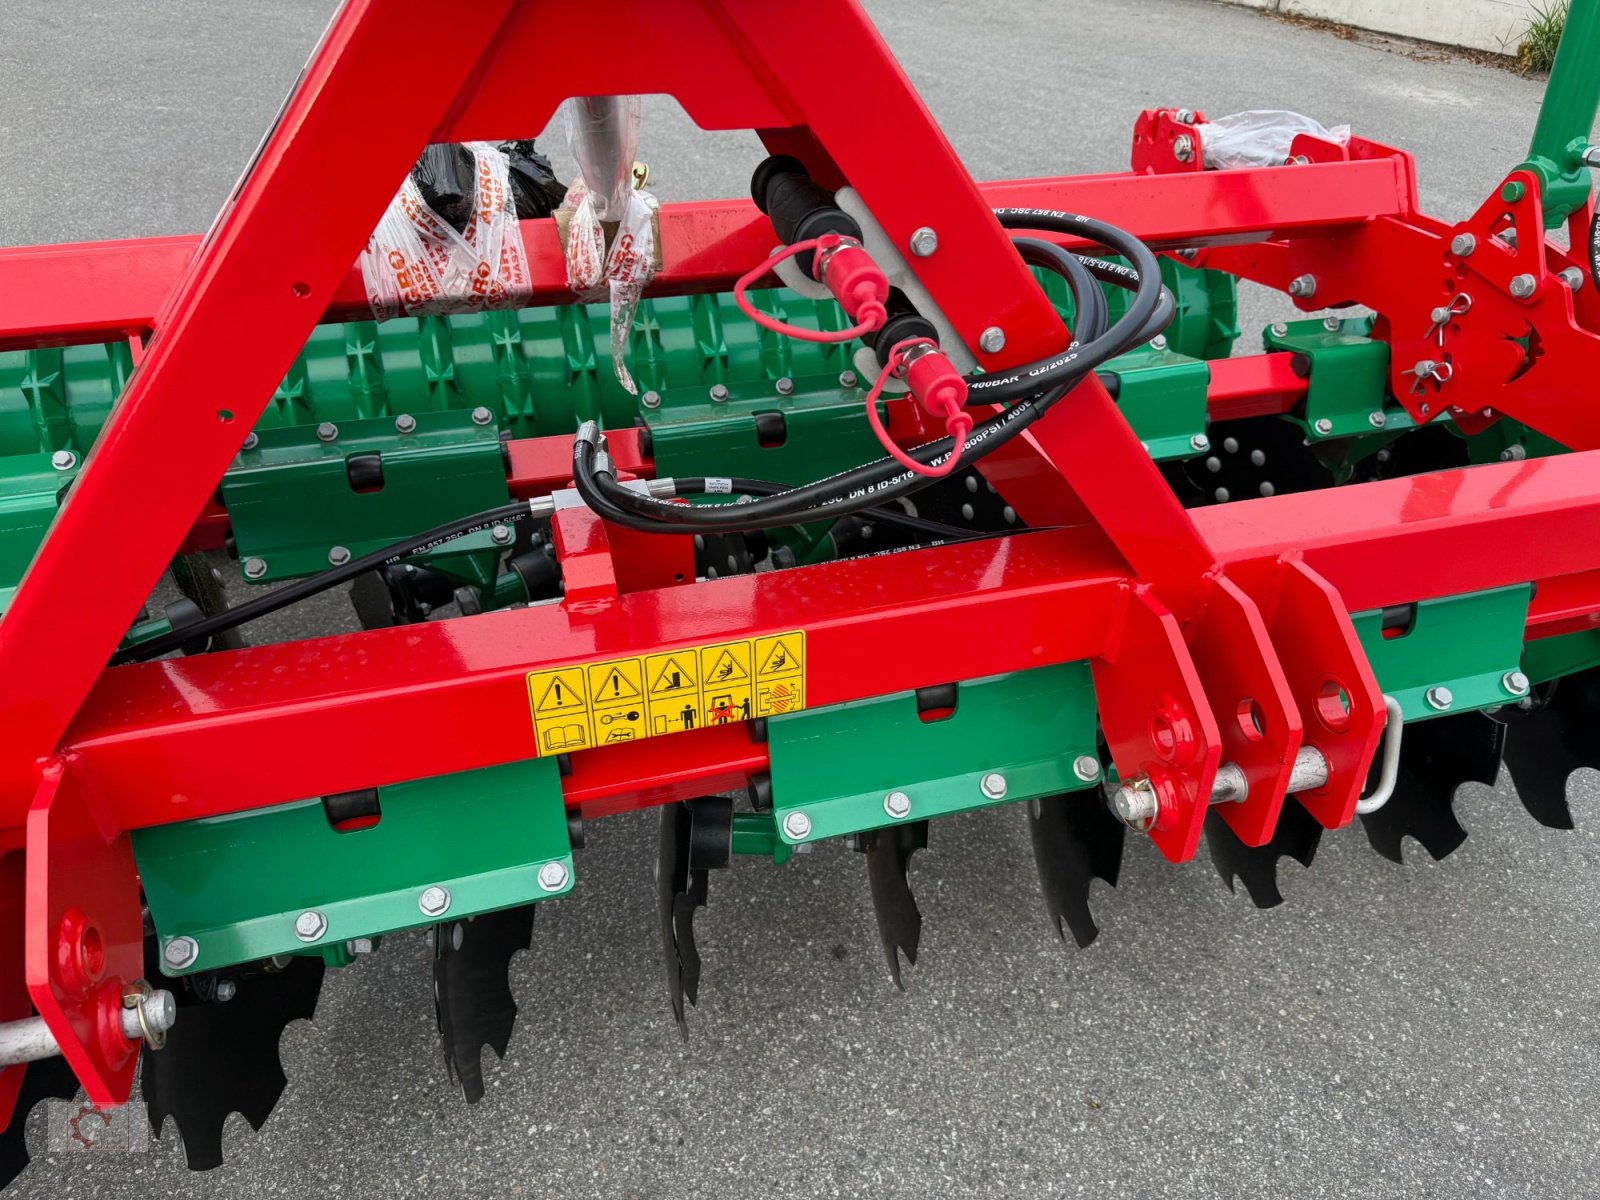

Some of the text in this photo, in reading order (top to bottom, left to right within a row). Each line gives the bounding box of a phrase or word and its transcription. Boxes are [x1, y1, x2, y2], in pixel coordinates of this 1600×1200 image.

[493, 179, 505, 213] MASZ
[1050, 210, 1066, 218] EN
[509, 245, 525, 285] MASZ
[1115, 265, 1129, 275] DN
[1028, 352, 1078, 378] Q2/2025
[848, 487, 865, 500] DN
[867, 484, 876, 494] 8
[960, 423, 1002, 454] 800PSI
[412, 545, 427, 555] EN
